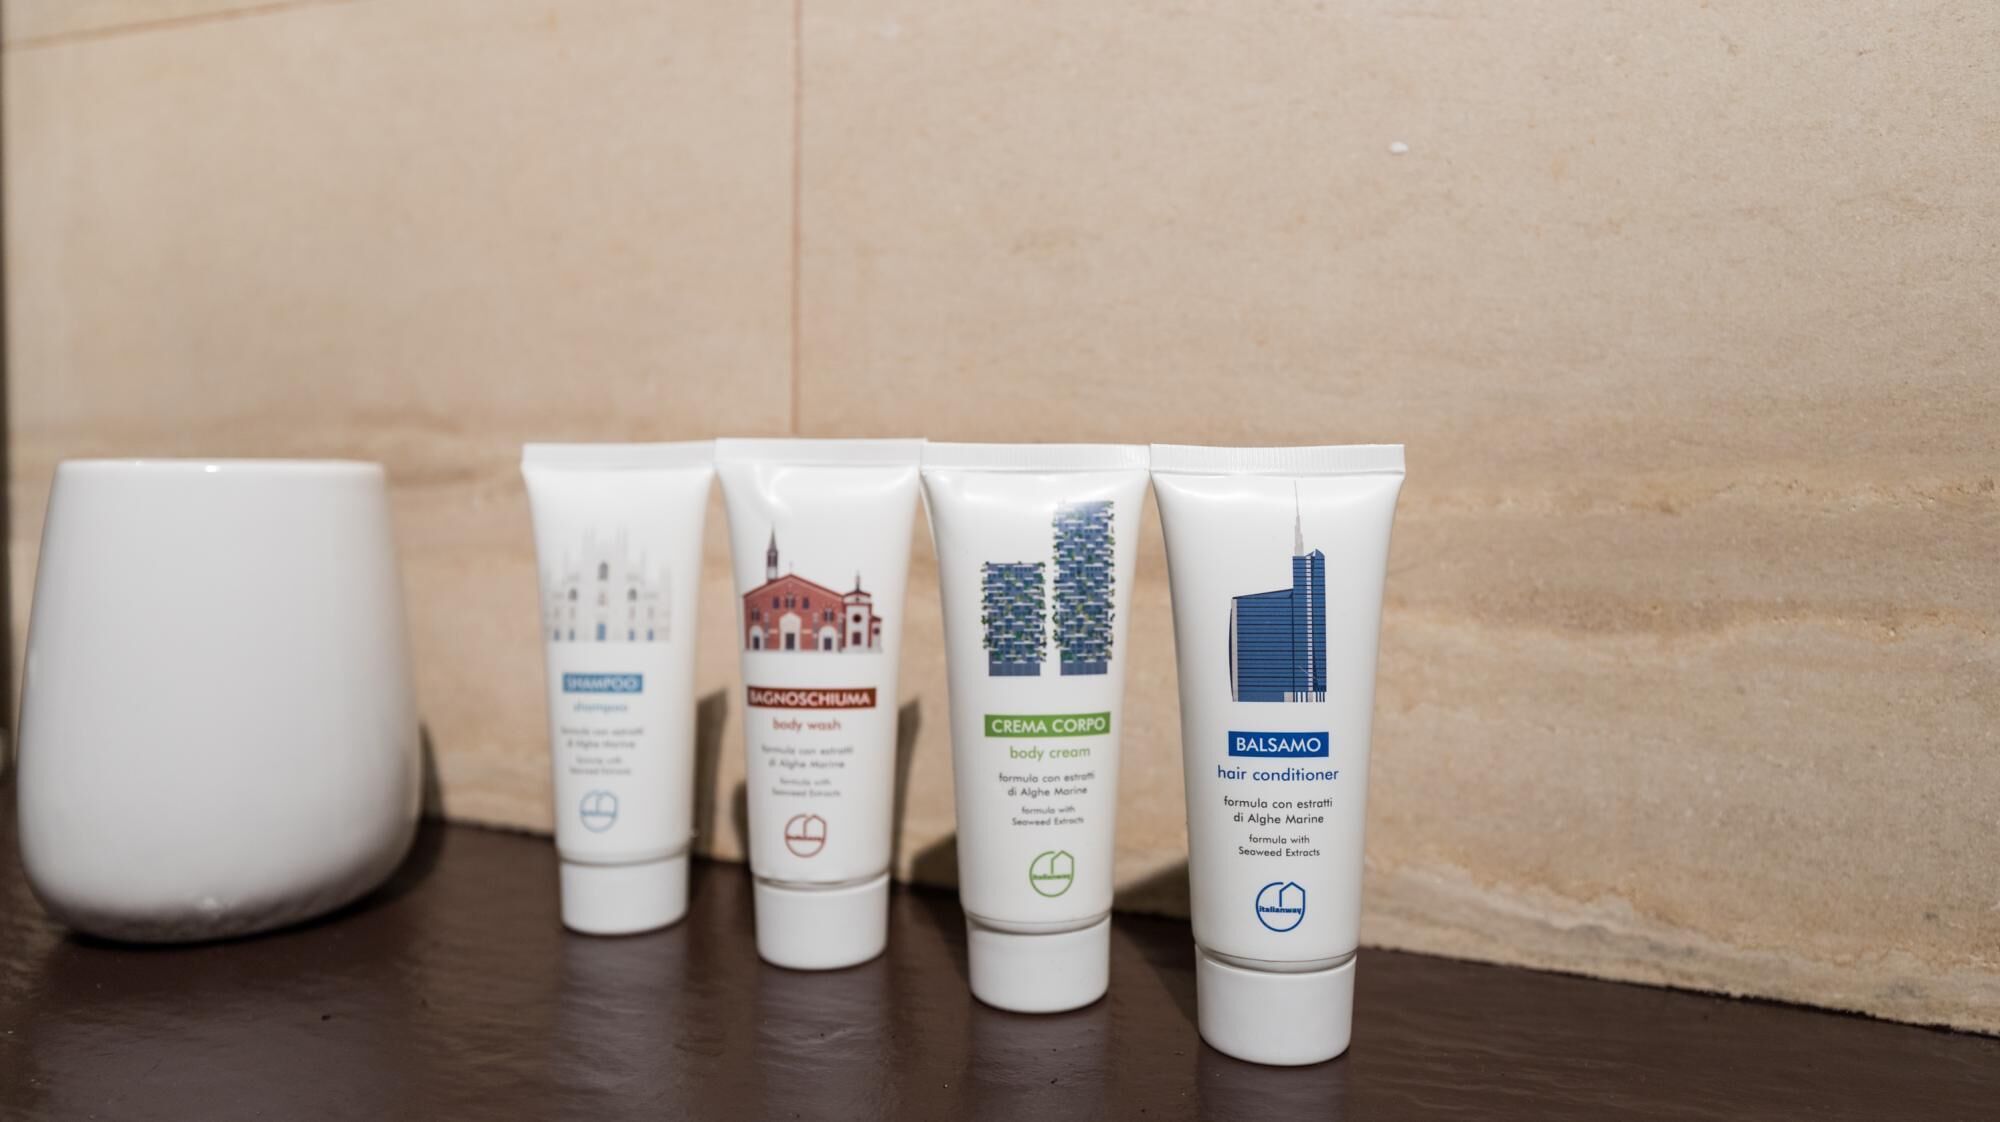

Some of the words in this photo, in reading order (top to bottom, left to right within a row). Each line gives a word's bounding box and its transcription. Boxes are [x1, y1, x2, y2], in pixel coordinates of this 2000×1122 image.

[567, 677, 638, 690] SHAMPOO
[772, 717, 803, 732] body
[807, 717, 842, 730] wash
[991, 719, 1048, 734] CREMA
[1052, 717, 1106, 733] CORPO
[761, 744, 796, 755] formula
[798, 746, 816, 755] con
[820, 744, 854, 755] estratti
[1236, 737, 1321, 753] BALSAMO
[1009, 746, 1045, 761] body
[1049, 747, 1091, 759] cream
[779, 759, 807, 770] Alghe
[810, 759, 846, 769] Marine
[999, 772, 1039, 784] formula
[1042, 774, 1061, 783] con
[1063, 771, 1095, 782] estratti
[1217, 765, 1247, 780] hair
[1252, 767, 1339, 782] conditioner
[1007, 787, 1017, 797] di
[1020, 787, 1050, 799] Alghe
[1054, 786, 1088, 797] Marine
[1224, 796, 1268, 809] formula
[1272, 799, 1293, 809] con
[1296, 797, 1333, 809] estratti
[1021, 806, 1055, 815] formula
[1058, 805, 1075, 814] with
[1011, 817, 1051, 827] Seaweed
[1053, 816, 1084, 826] Extracts
[1233, 812, 1243, 823] di
[1247, 813, 1281, 826] Alghe
[1285, 813, 1324, 824] Marine
[1249, 834, 1287, 845] formula
[1290, 835, 1310, 844] with
[1238, 846, 1282, 857] Seaweed
[1285, 848, 1320, 857] Extracts
[1259, 905, 1302, 915] italianway
